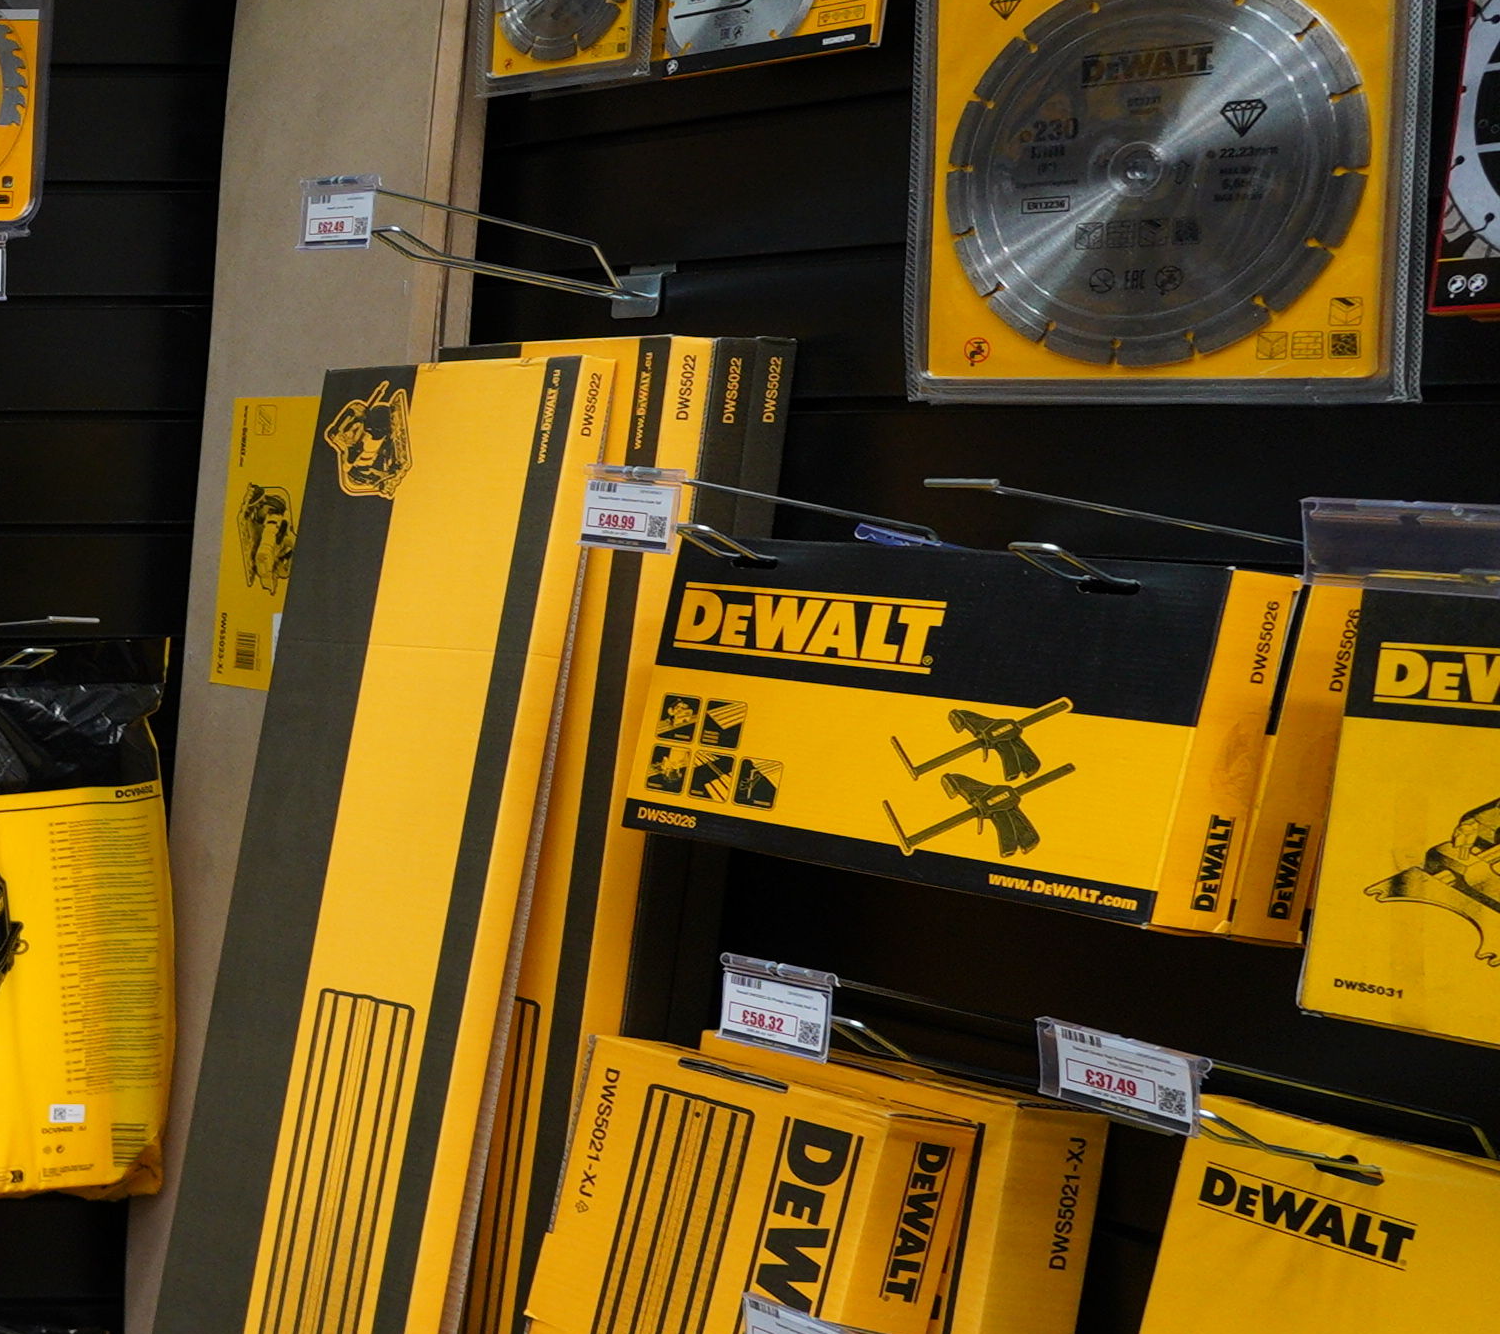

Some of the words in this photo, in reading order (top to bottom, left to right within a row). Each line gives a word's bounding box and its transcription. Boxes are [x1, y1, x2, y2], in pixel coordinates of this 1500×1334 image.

[600, 515, 636, 529] £49.99
[673, 589, 945, 674] DEWALT
[1250, 601, 1282, 684] DWS5026
[637, 807, 696, 828] DWS5026
[740, 1010, 784, 1033] £58.32
[1334, 978, 1403, 999] DWS5031
[1085, 1070, 1137, 1097] £37.49
[575, 1067, 620, 1213] DWS5021-XJ
[882, 1142, 954, 1304] DEWALT
[1049, 1137, 1088, 1270] DWS5021-XJ
[1198, 1167, 1416, 1270] DEWALT
